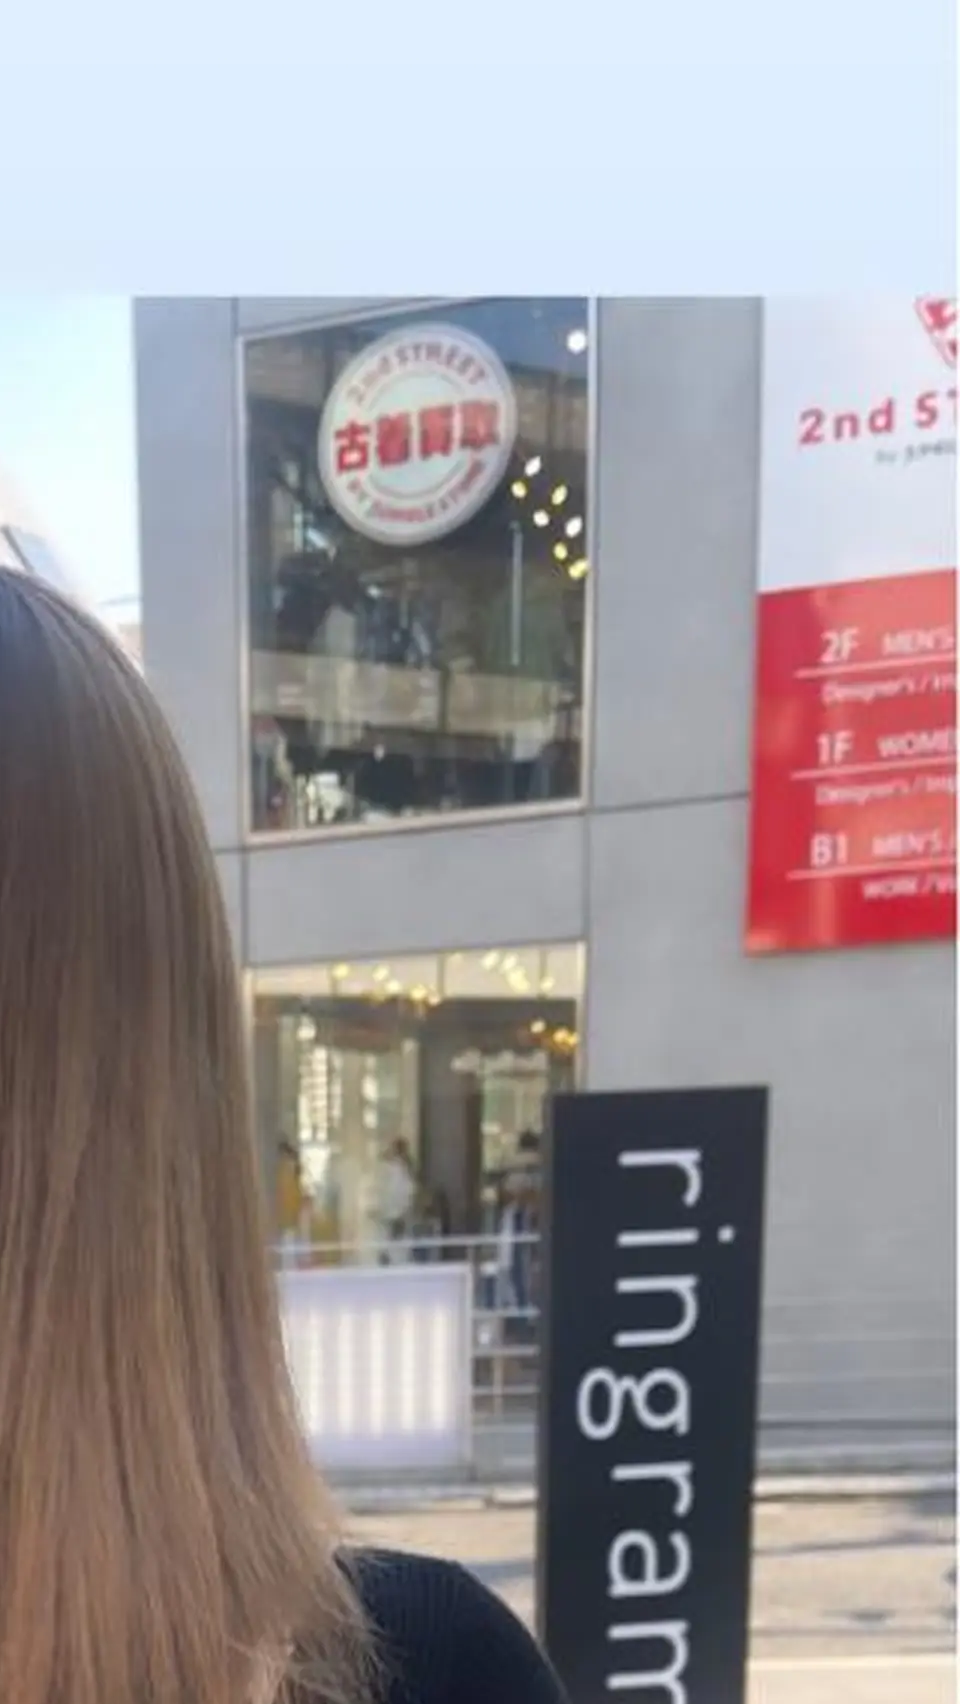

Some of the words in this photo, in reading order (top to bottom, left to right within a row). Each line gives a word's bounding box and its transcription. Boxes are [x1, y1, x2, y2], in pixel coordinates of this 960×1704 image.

[799, 397, 895, 445] 2nd
[819, 627, 859, 664] 2F
[882, 627, 951, 656] MEN'S
[816, 730, 855, 766] 1F
[810, 831, 848, 867] B1
[872, 829, 942, 859] MEN'S
